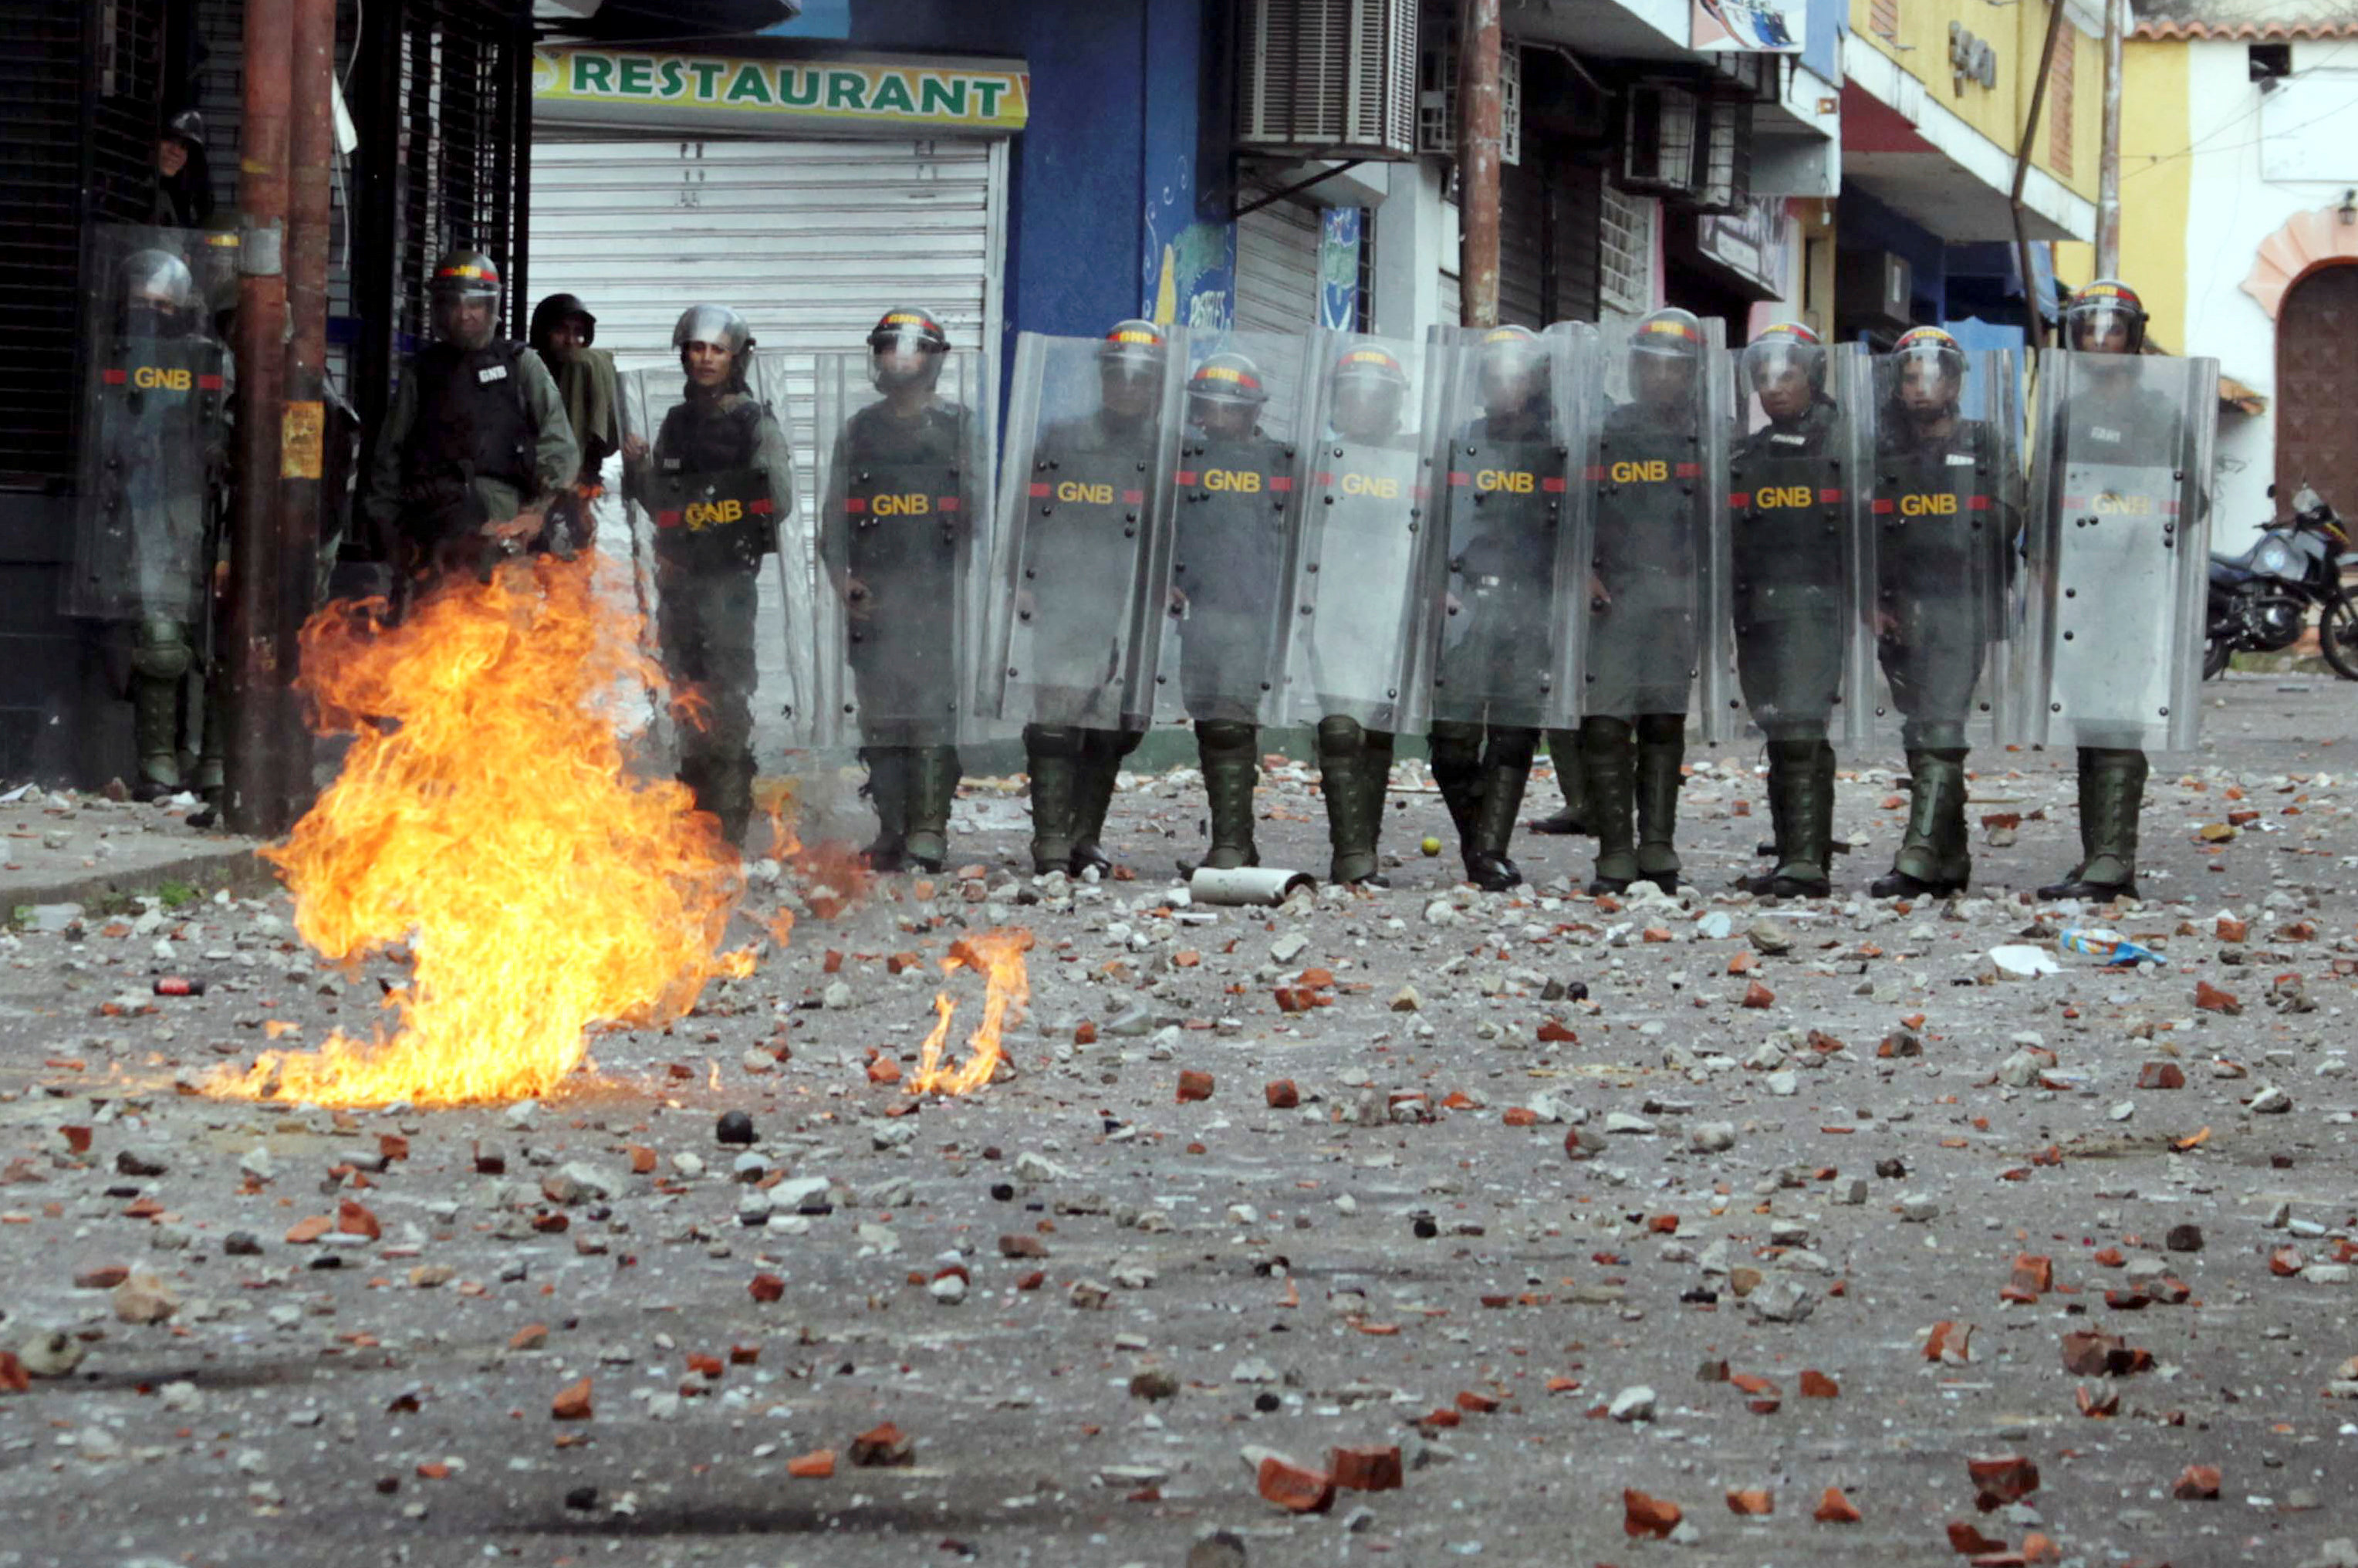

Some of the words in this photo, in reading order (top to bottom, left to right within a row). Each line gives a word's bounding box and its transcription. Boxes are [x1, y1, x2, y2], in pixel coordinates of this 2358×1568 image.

[573, 55, 1007, 117] RESTAURANT
[134, 367, 192, 390] GNB
[478, 366, 507, 383] GNB
[1204, 468, 1261, 492] GNB
[1476, 469, 1535, 493] GNB
[1611, 461, 1669, 483] GNB
[1057, 482, 1113, 504] GNB
[1341, 473, 1399, 499] GNB
[1756, 486, 1812, 509] GNB
[685, 499, 743, 529] GNB
[872, 493, 929, 515] GNB
[1900, 493, 1958, 515] GNB
[2093, 493, 2150, 515] GNB
